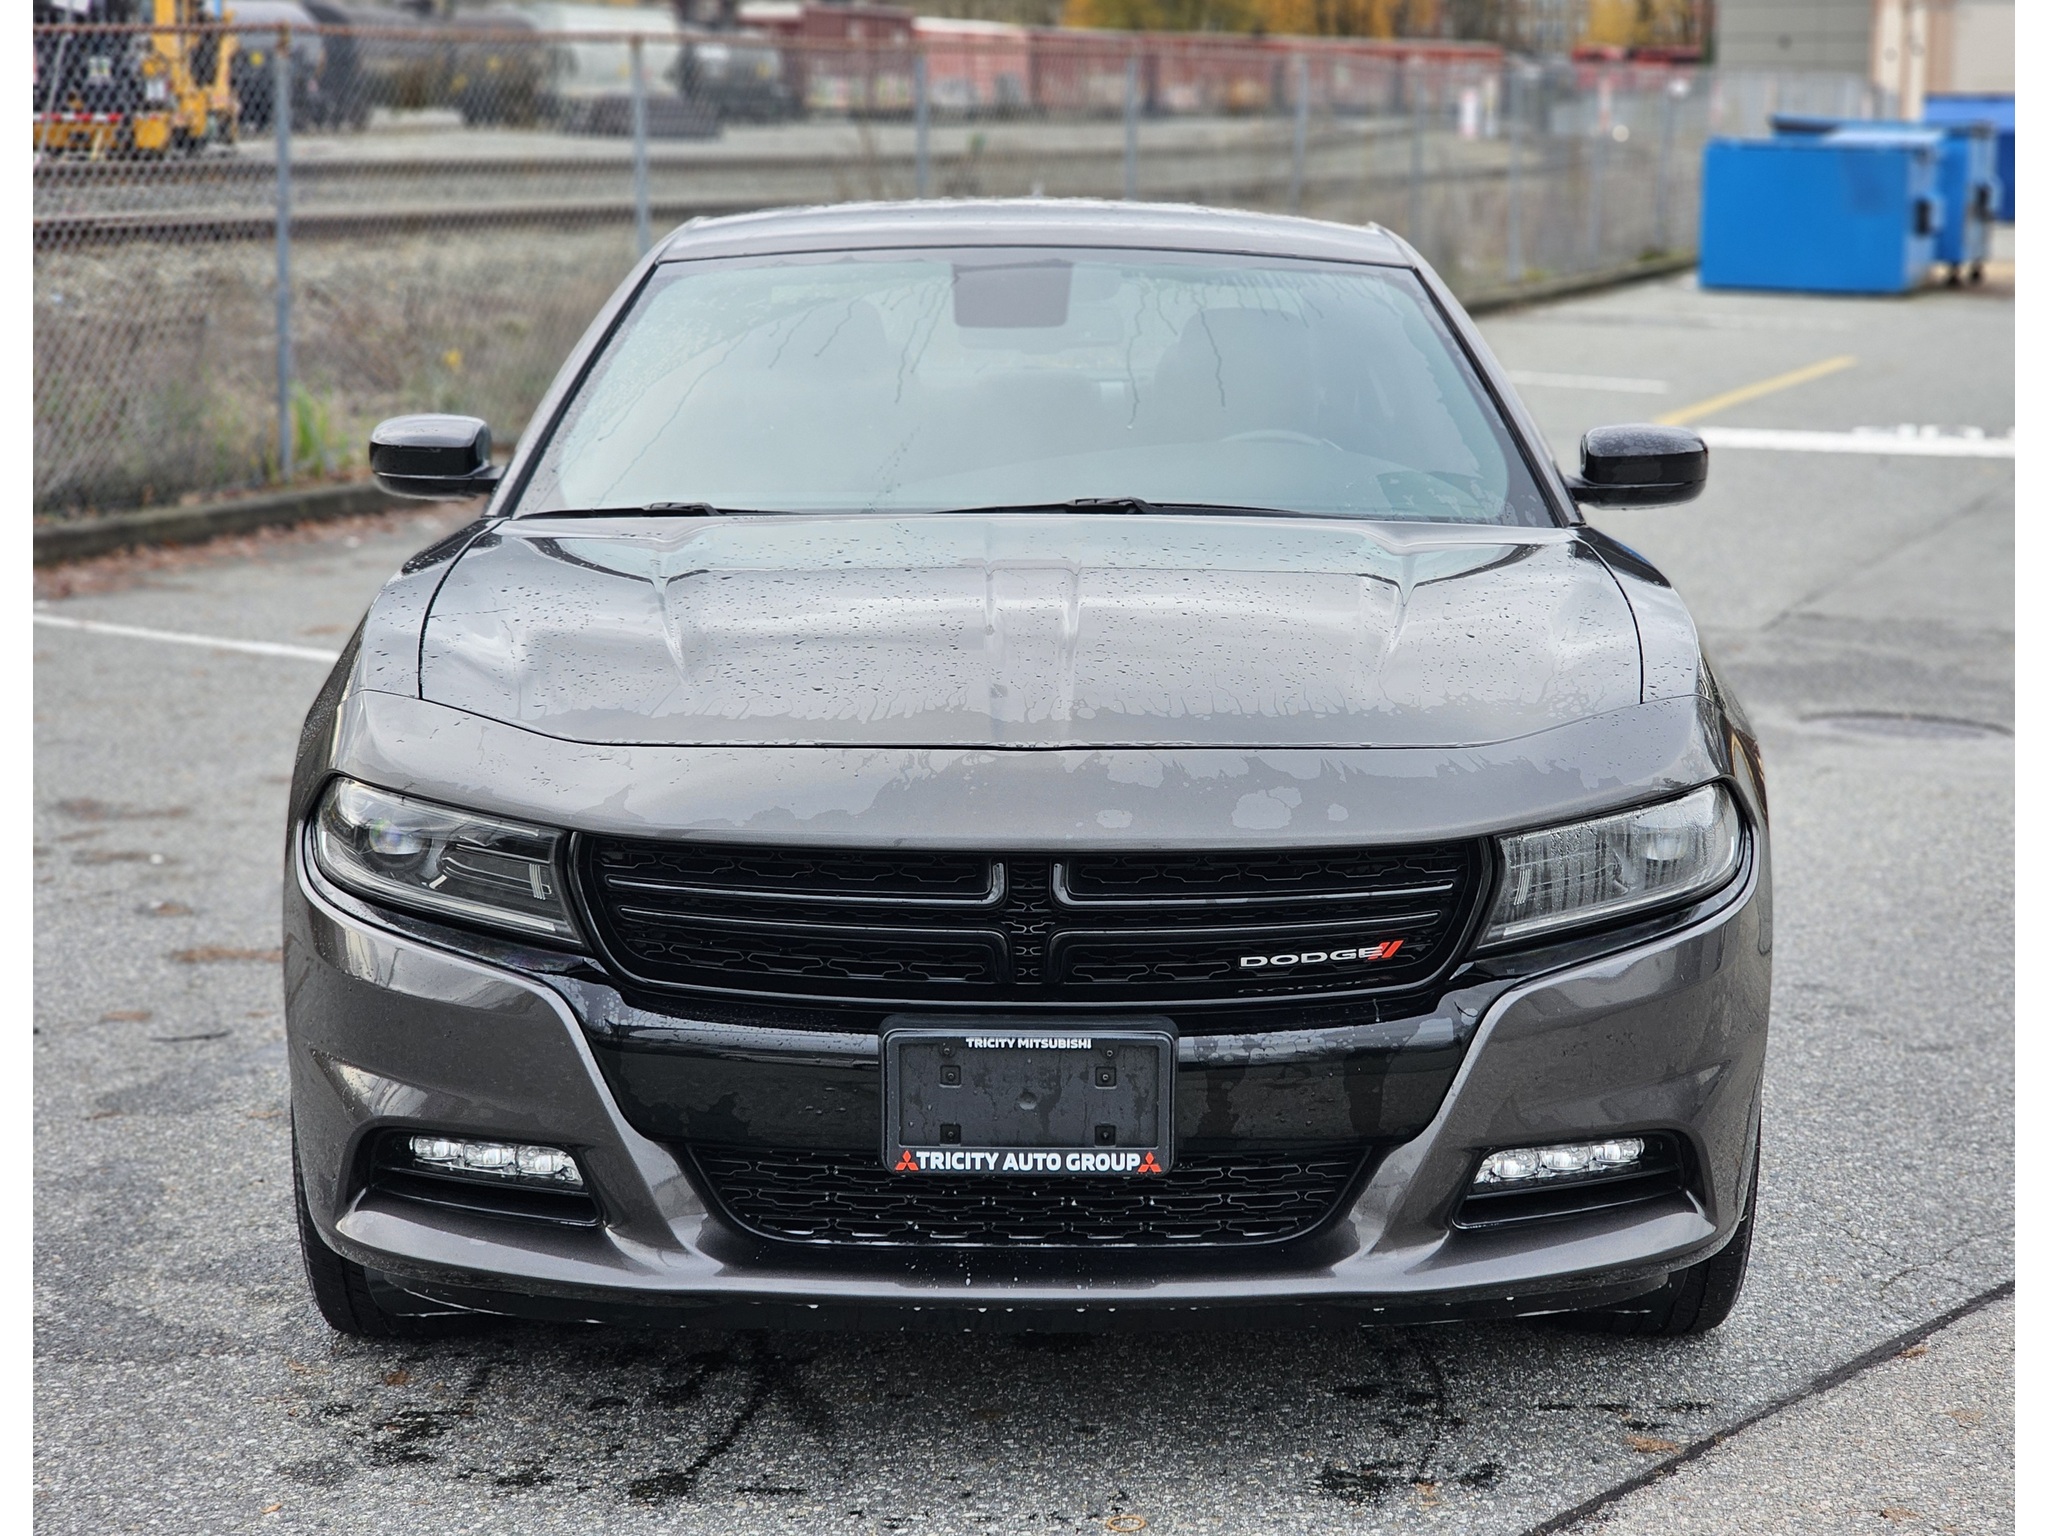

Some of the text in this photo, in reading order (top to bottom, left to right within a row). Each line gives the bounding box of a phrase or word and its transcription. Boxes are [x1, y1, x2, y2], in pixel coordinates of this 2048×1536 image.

[1240, 946, 1383, 968] DODGE
[966, 1037, 1092, 1049] TRICITY MITSUBISHI
[916, 1151, 1141, 1171] TRICITY AUTO GROUP
